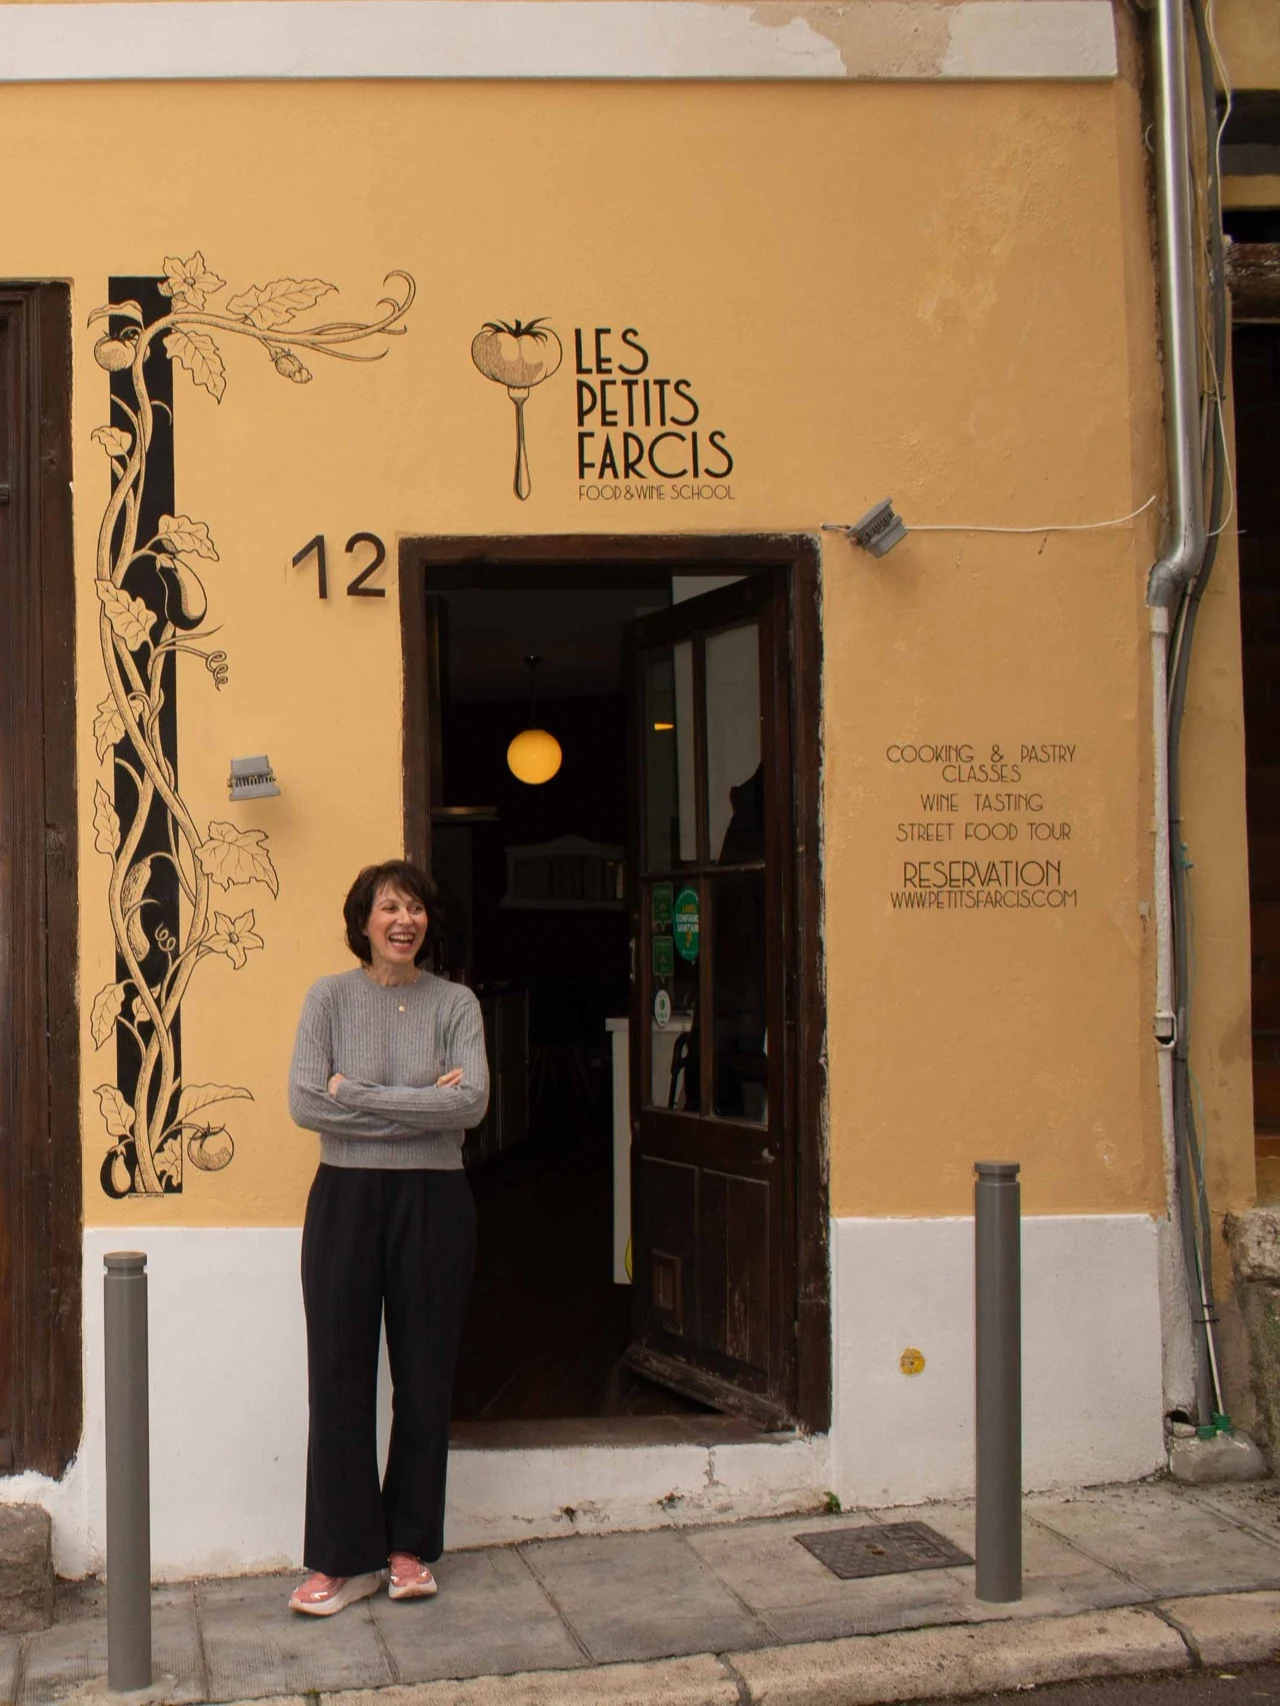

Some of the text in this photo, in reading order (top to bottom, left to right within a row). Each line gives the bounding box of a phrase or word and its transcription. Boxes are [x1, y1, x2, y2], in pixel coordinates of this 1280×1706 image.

[575, 328, 649, 375] LES
[577, 379, 699, 427] PETITS
[577, 431, 733, 479] FARCIS
[579, 485, 622, 500] FOOD
[635, 485, 665, 500] WINE
[671, 484, 735, 500] SCHOOL
[292, 532, 385, 599] 12
[886, 744, 1076, 763] COOKING & PASTRY
[942, 764, 1021, 783] CLASSES
[920, 793, 1043, 812] WINE TASTING
[896, 822, 1071, 842] STREET FOOD TOUR
[903, 860, 1061, 888] RESERVATION
[890, 889, 1078, 909] WWW.PETITSFARCIS.COM
